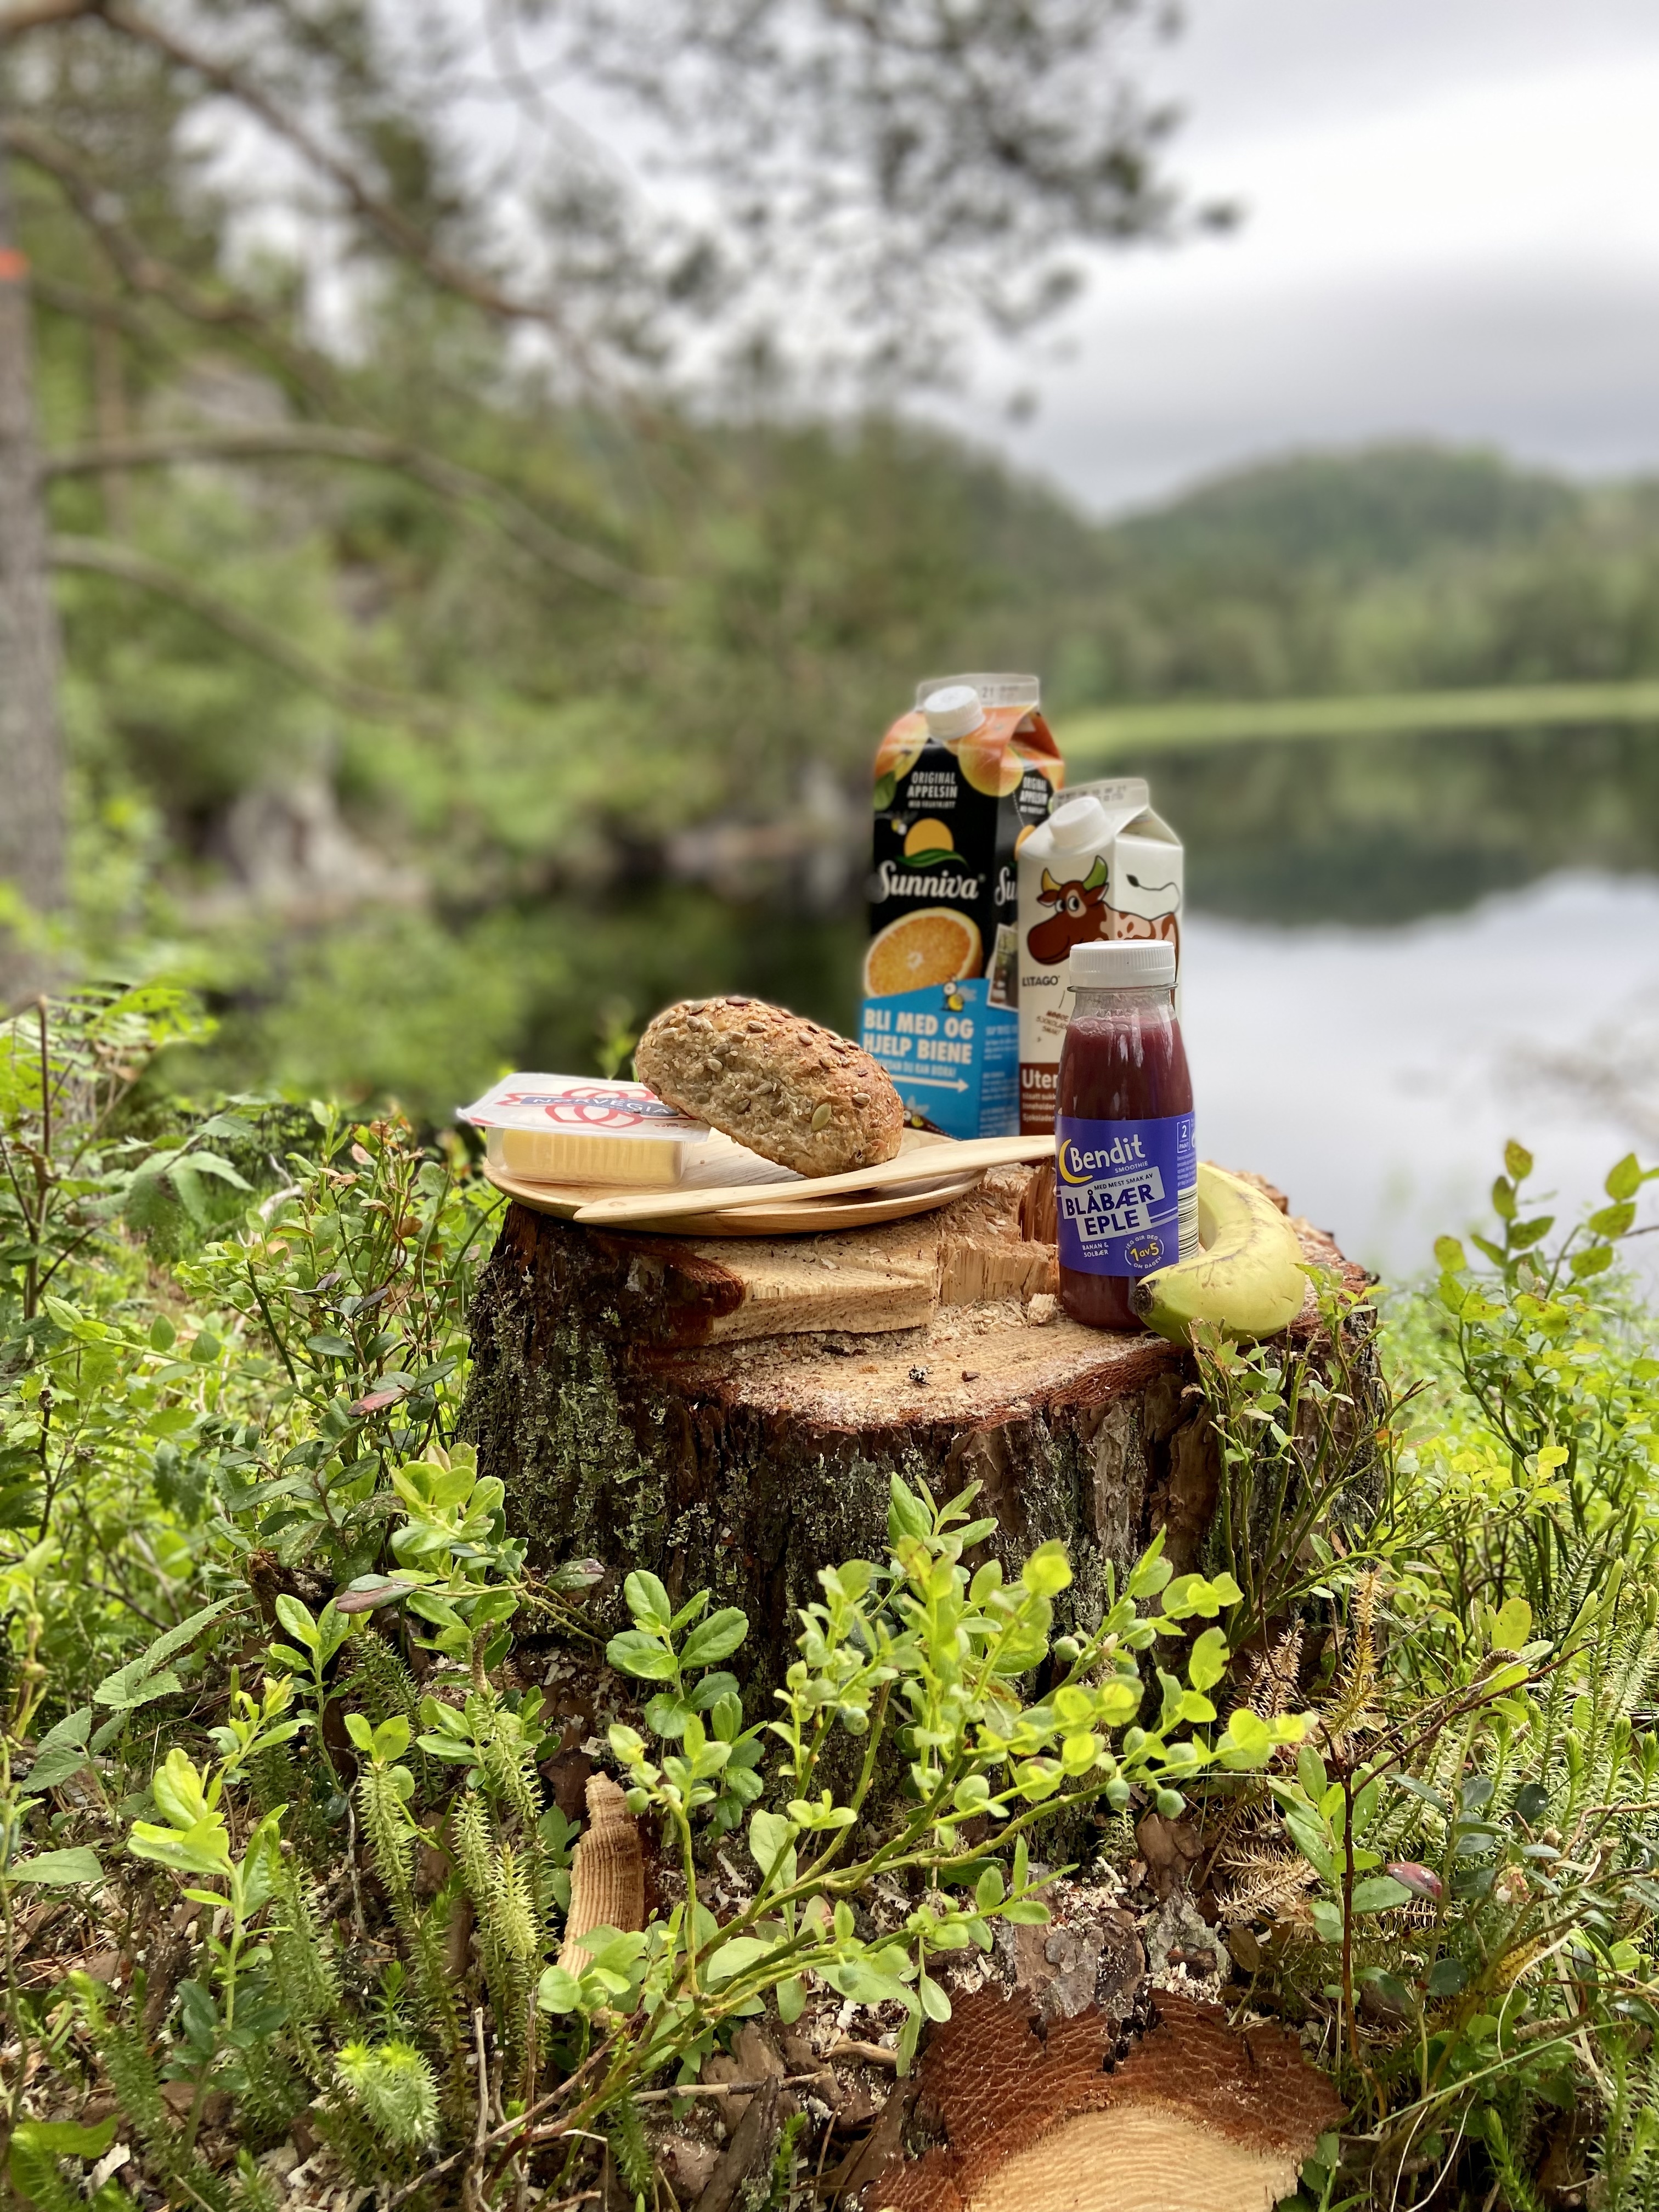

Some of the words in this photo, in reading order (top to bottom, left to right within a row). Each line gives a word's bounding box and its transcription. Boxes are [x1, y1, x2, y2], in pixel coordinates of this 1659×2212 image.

[911, 771, 956, 784] ORIGINAL
[906, 785, 958, 798] APPELSIN
[878, 859, 980, 901] Sunniva
[1022, 975, 1059, 987] LITAGO
[864, 1008, 891, 1031] BLI
[895, 1011, 939, 1036] MED
[944, 1016, 974, 1040] OG
[862, 1032, 912, 1057] HJELP
[917, 1038, 973, 1065] BIENE
[533, 1098, 670, 1114] NORVEGIA
[1182, 1125, 1187, 1138] 2
[1179, 1142, 1189, 1150] PANT
[1070, 1134, 1146, 1172] Bendit
[1114, 1160, 1149, 1173] SMOOTHIE
[1126, 1176, 1144, 1185] SMAK
[1065, 1184, 1155, 1216] BLÅBÆR
[1084, 1209, 1140, 1235] EPLE
[1082, 1243, 1103, 1251] BANAN
[1125, 1240, 1135, 1250] JEG
[1084, 1249, 1109, 1258] SOLBÆR
[1144, 1256, 1163, 1269] DAGEN
